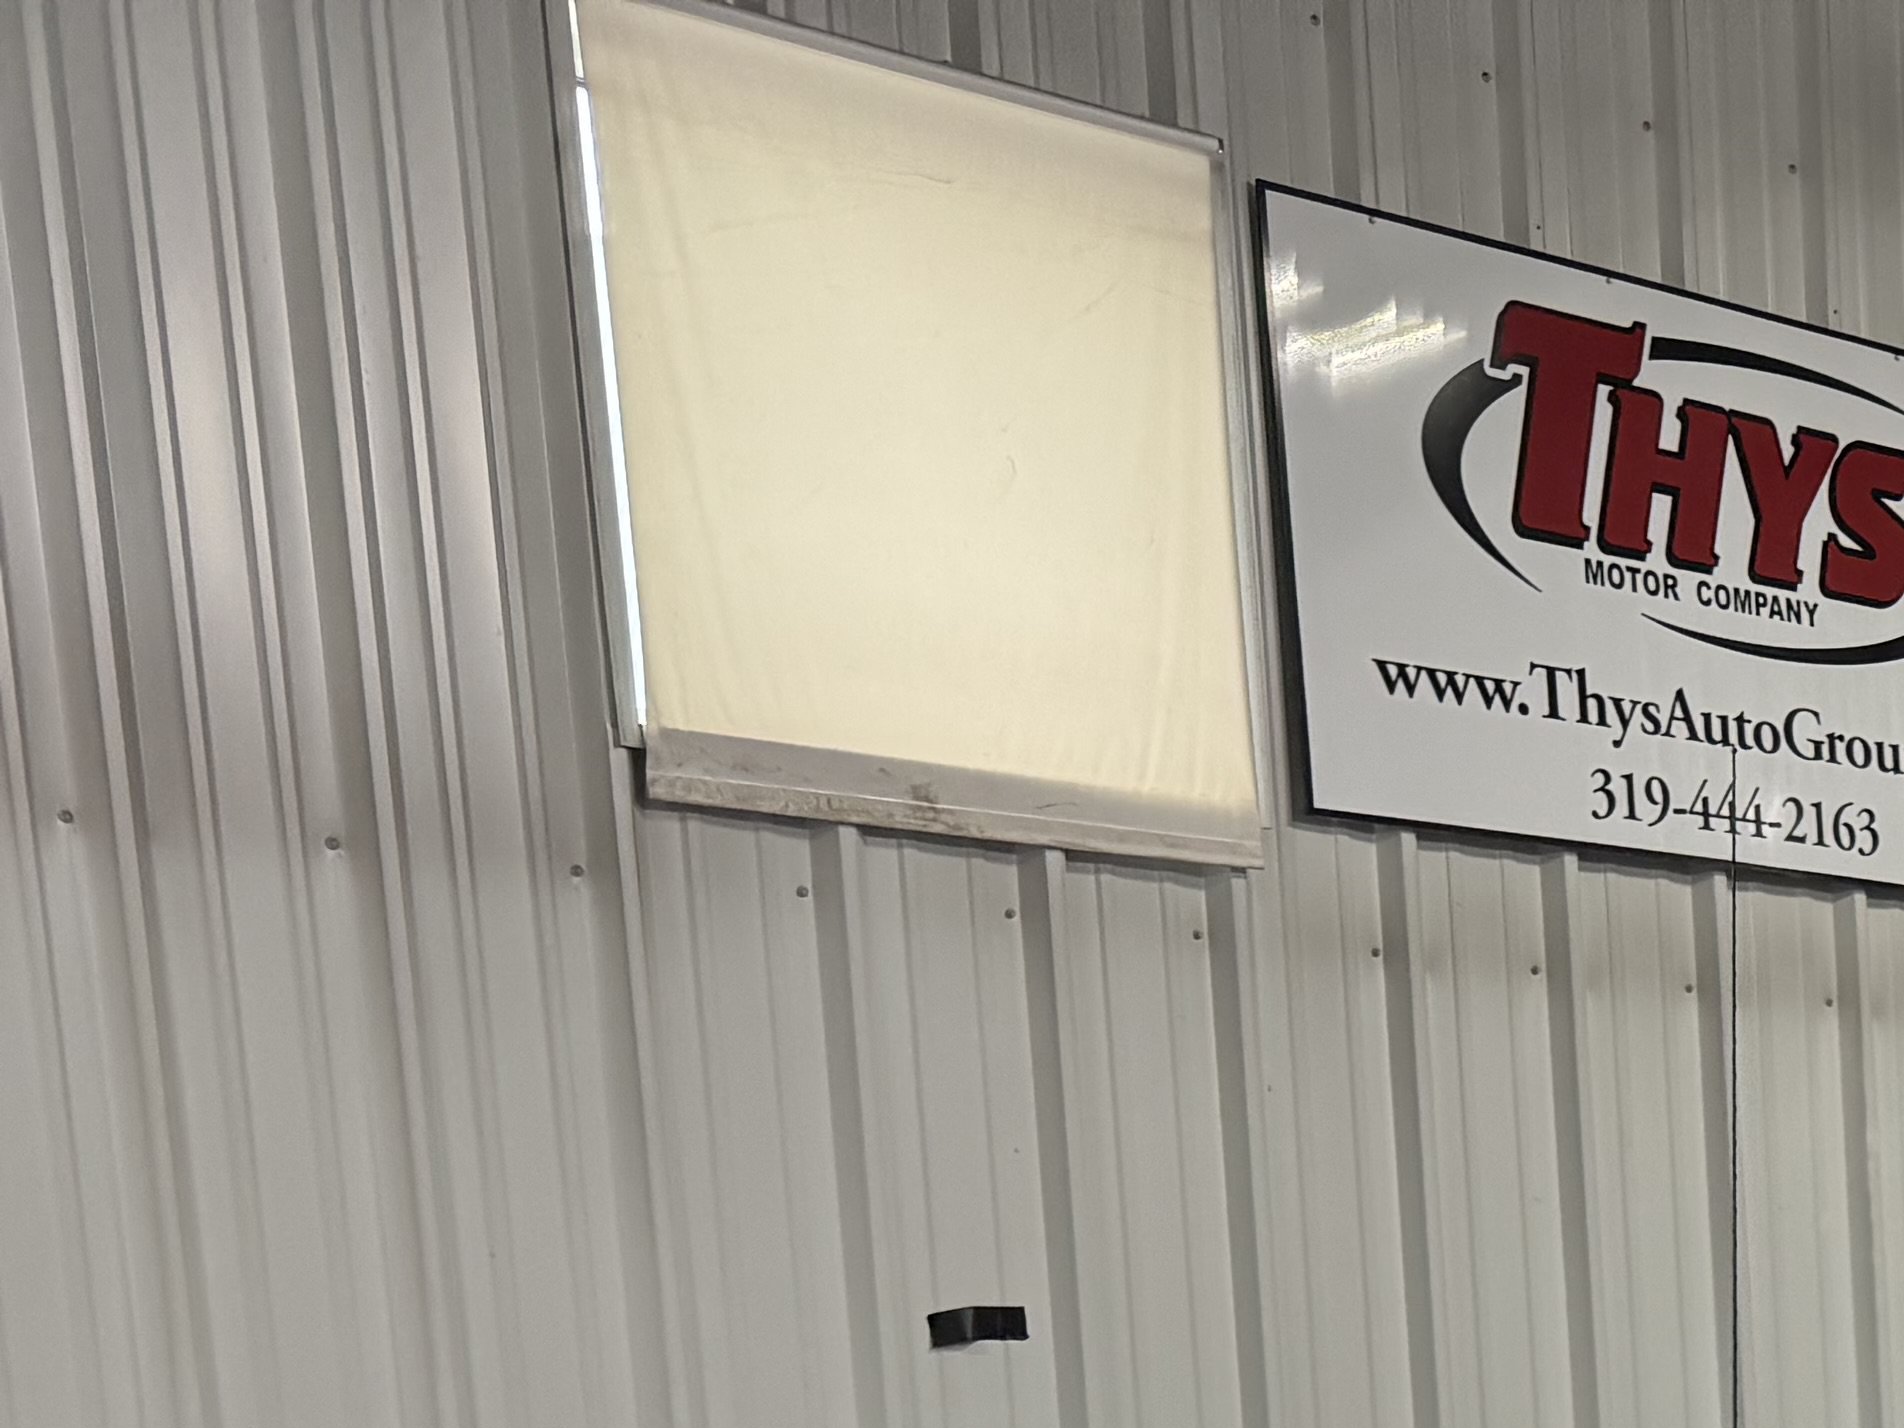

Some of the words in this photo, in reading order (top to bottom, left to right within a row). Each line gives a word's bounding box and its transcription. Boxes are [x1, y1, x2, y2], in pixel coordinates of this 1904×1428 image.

[1584, 558, 1680, 602] MOTOR
[1697, 580, 1819, 628] COMPANY
[1590, 768, 1881, 857] 319-444-2163
